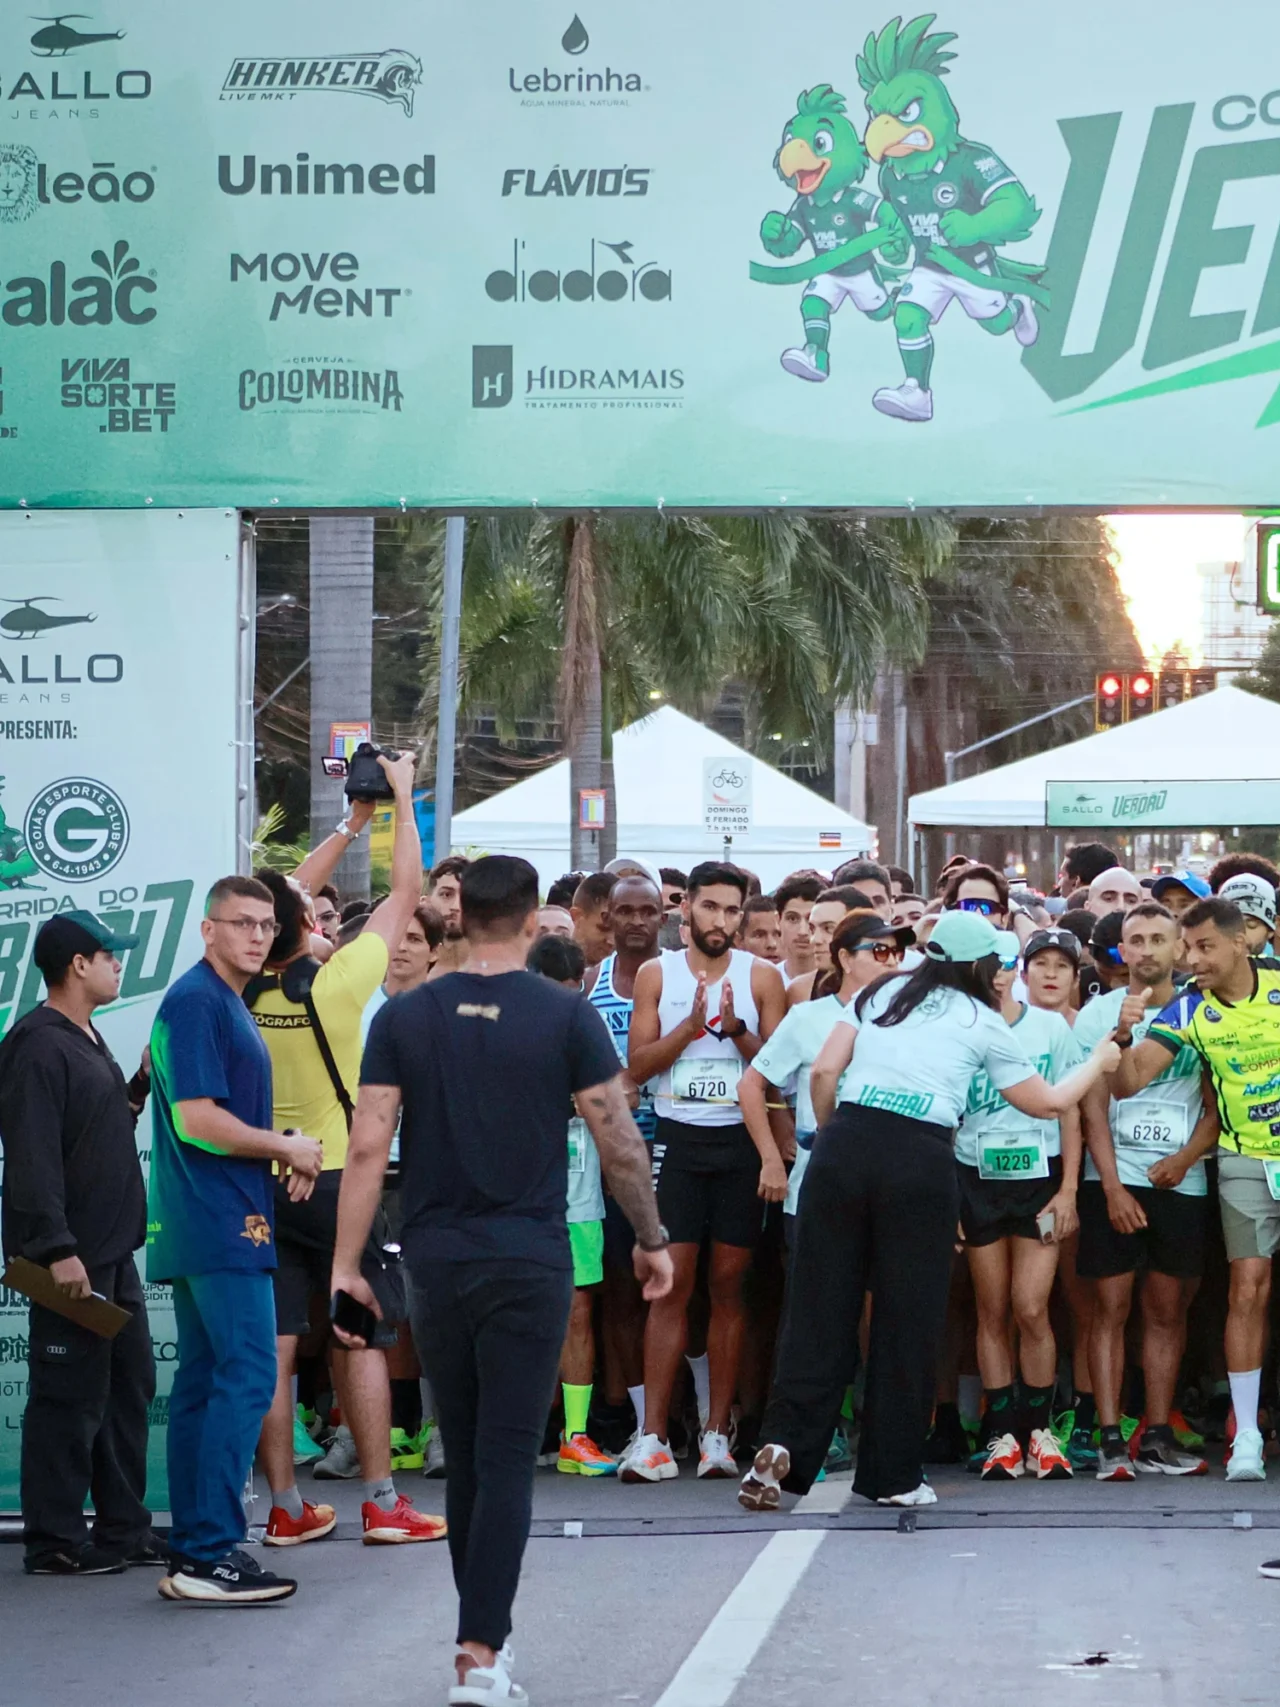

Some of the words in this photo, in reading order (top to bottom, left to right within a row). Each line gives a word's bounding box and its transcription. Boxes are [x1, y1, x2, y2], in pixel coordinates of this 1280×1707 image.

[0, 70, 152, 100] ALLO
[228, 60, 378, 88] HANKER
[508, 67, 642, 93] Lebrinha
[11, 109, 100, 119] JEANS
[589, 100, 630, 108] NATURAL
[218, 152, 436, 195] Unimed
[485, 238, 672, 303] diadora
[0, 260, 158, 327] alac
[61, 358, 130, 382] VIVA
[525, 366, 685, 394] HIDRAMAIS
[61, 383, 176, 408] SORTE
[238, 369, 404, 412] COLOMBINA
[44, 784, 107, 808] ESPORTE
[105, 803, 122, 852] CLUBE
[1062, 805, 1103, 814] SALLO
[51, 859, 102, 876] 6-4-1943
[98, 886, 139, 907] DO
[688, 1081, 727, 1098] 6720
[1133, 1124, 1172, 1142] 6282
[995, 1154, 1031, 1172] 1229
[212, 1566, 240, 1582] FILA
